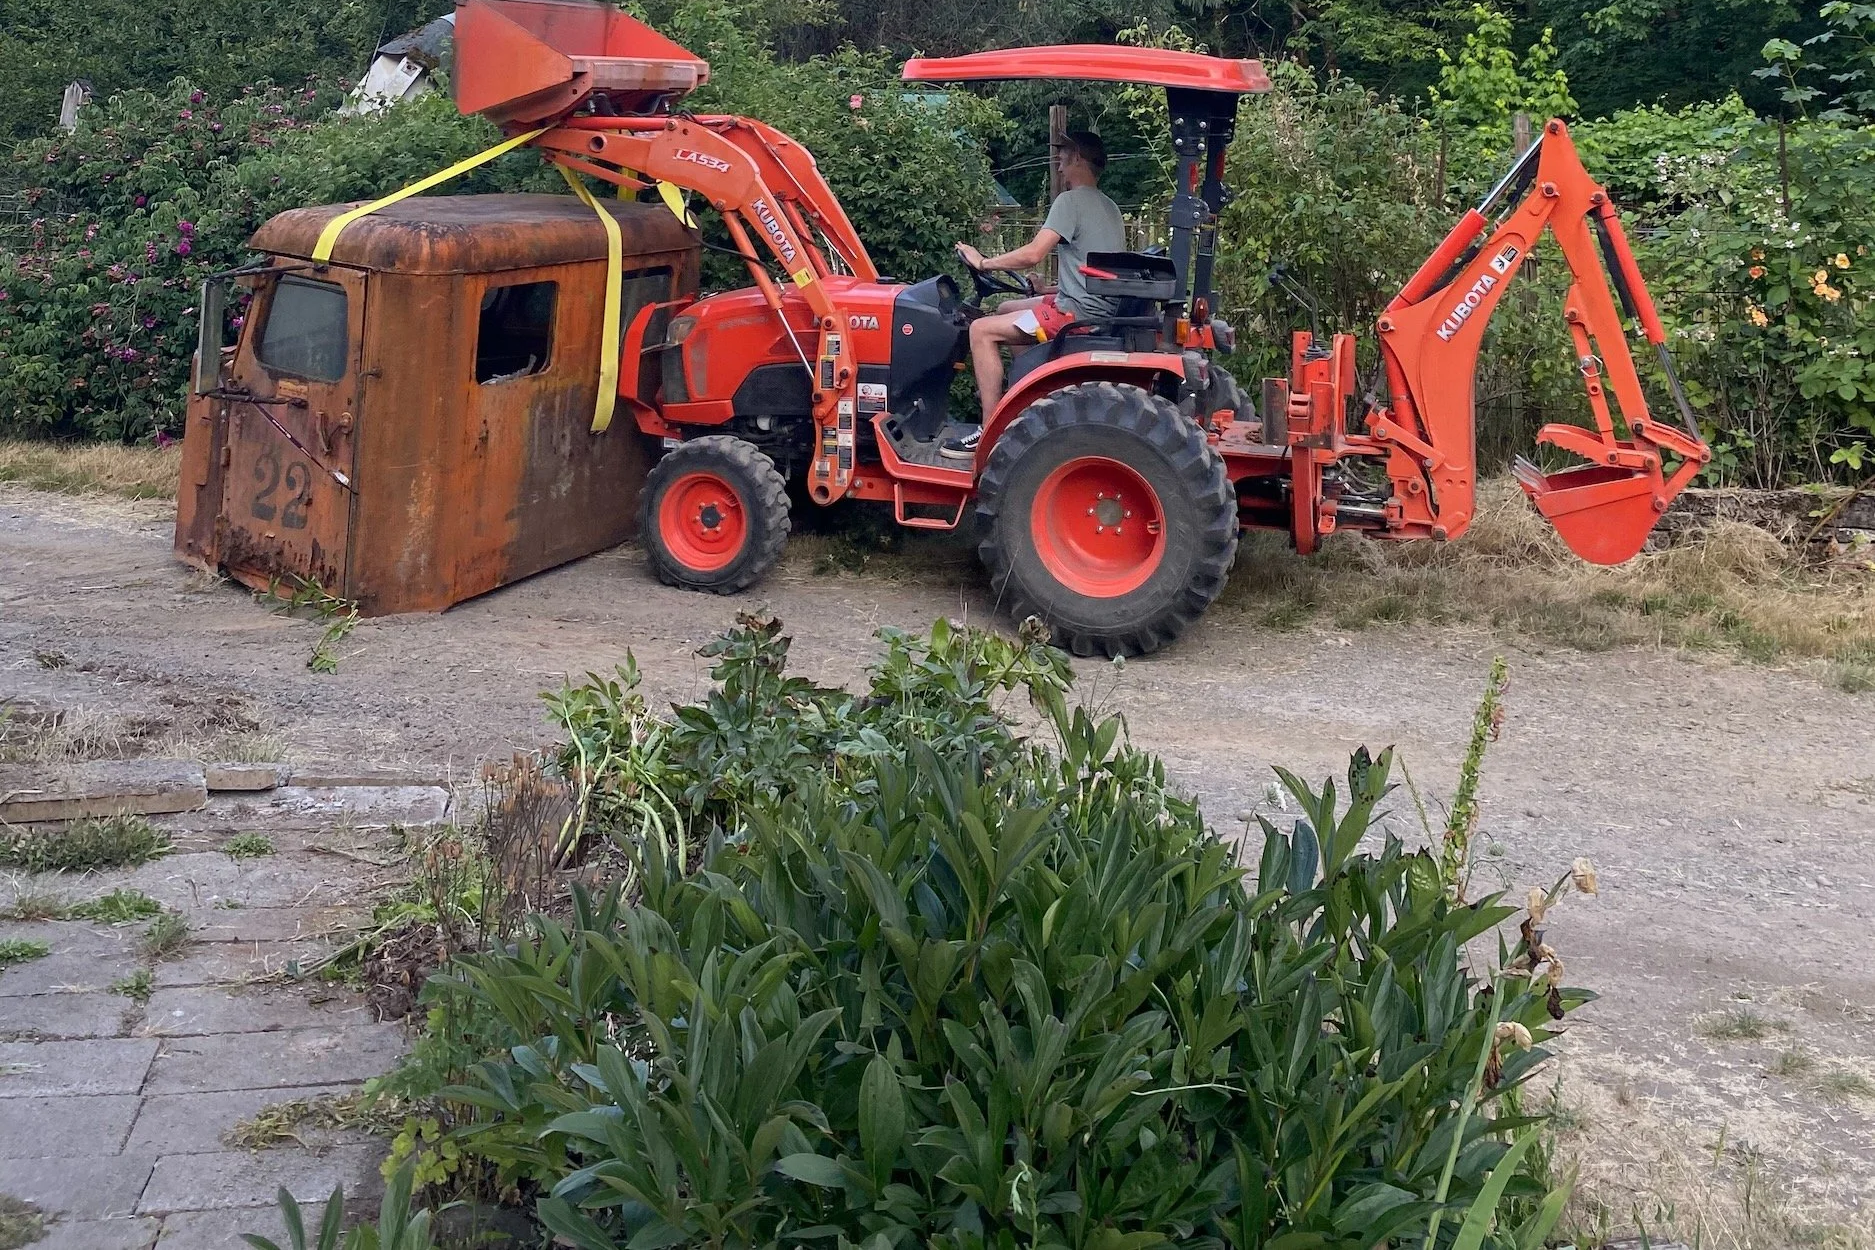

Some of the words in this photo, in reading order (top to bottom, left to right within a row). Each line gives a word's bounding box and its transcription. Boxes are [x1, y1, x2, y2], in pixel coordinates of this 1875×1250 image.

[673, 149, 732, 174] LA534
[751, 197, 798, 265] KUBOTA
[1436, 274, 1499, 342] KUBOTA
[251, 453, 311, 529] 22
